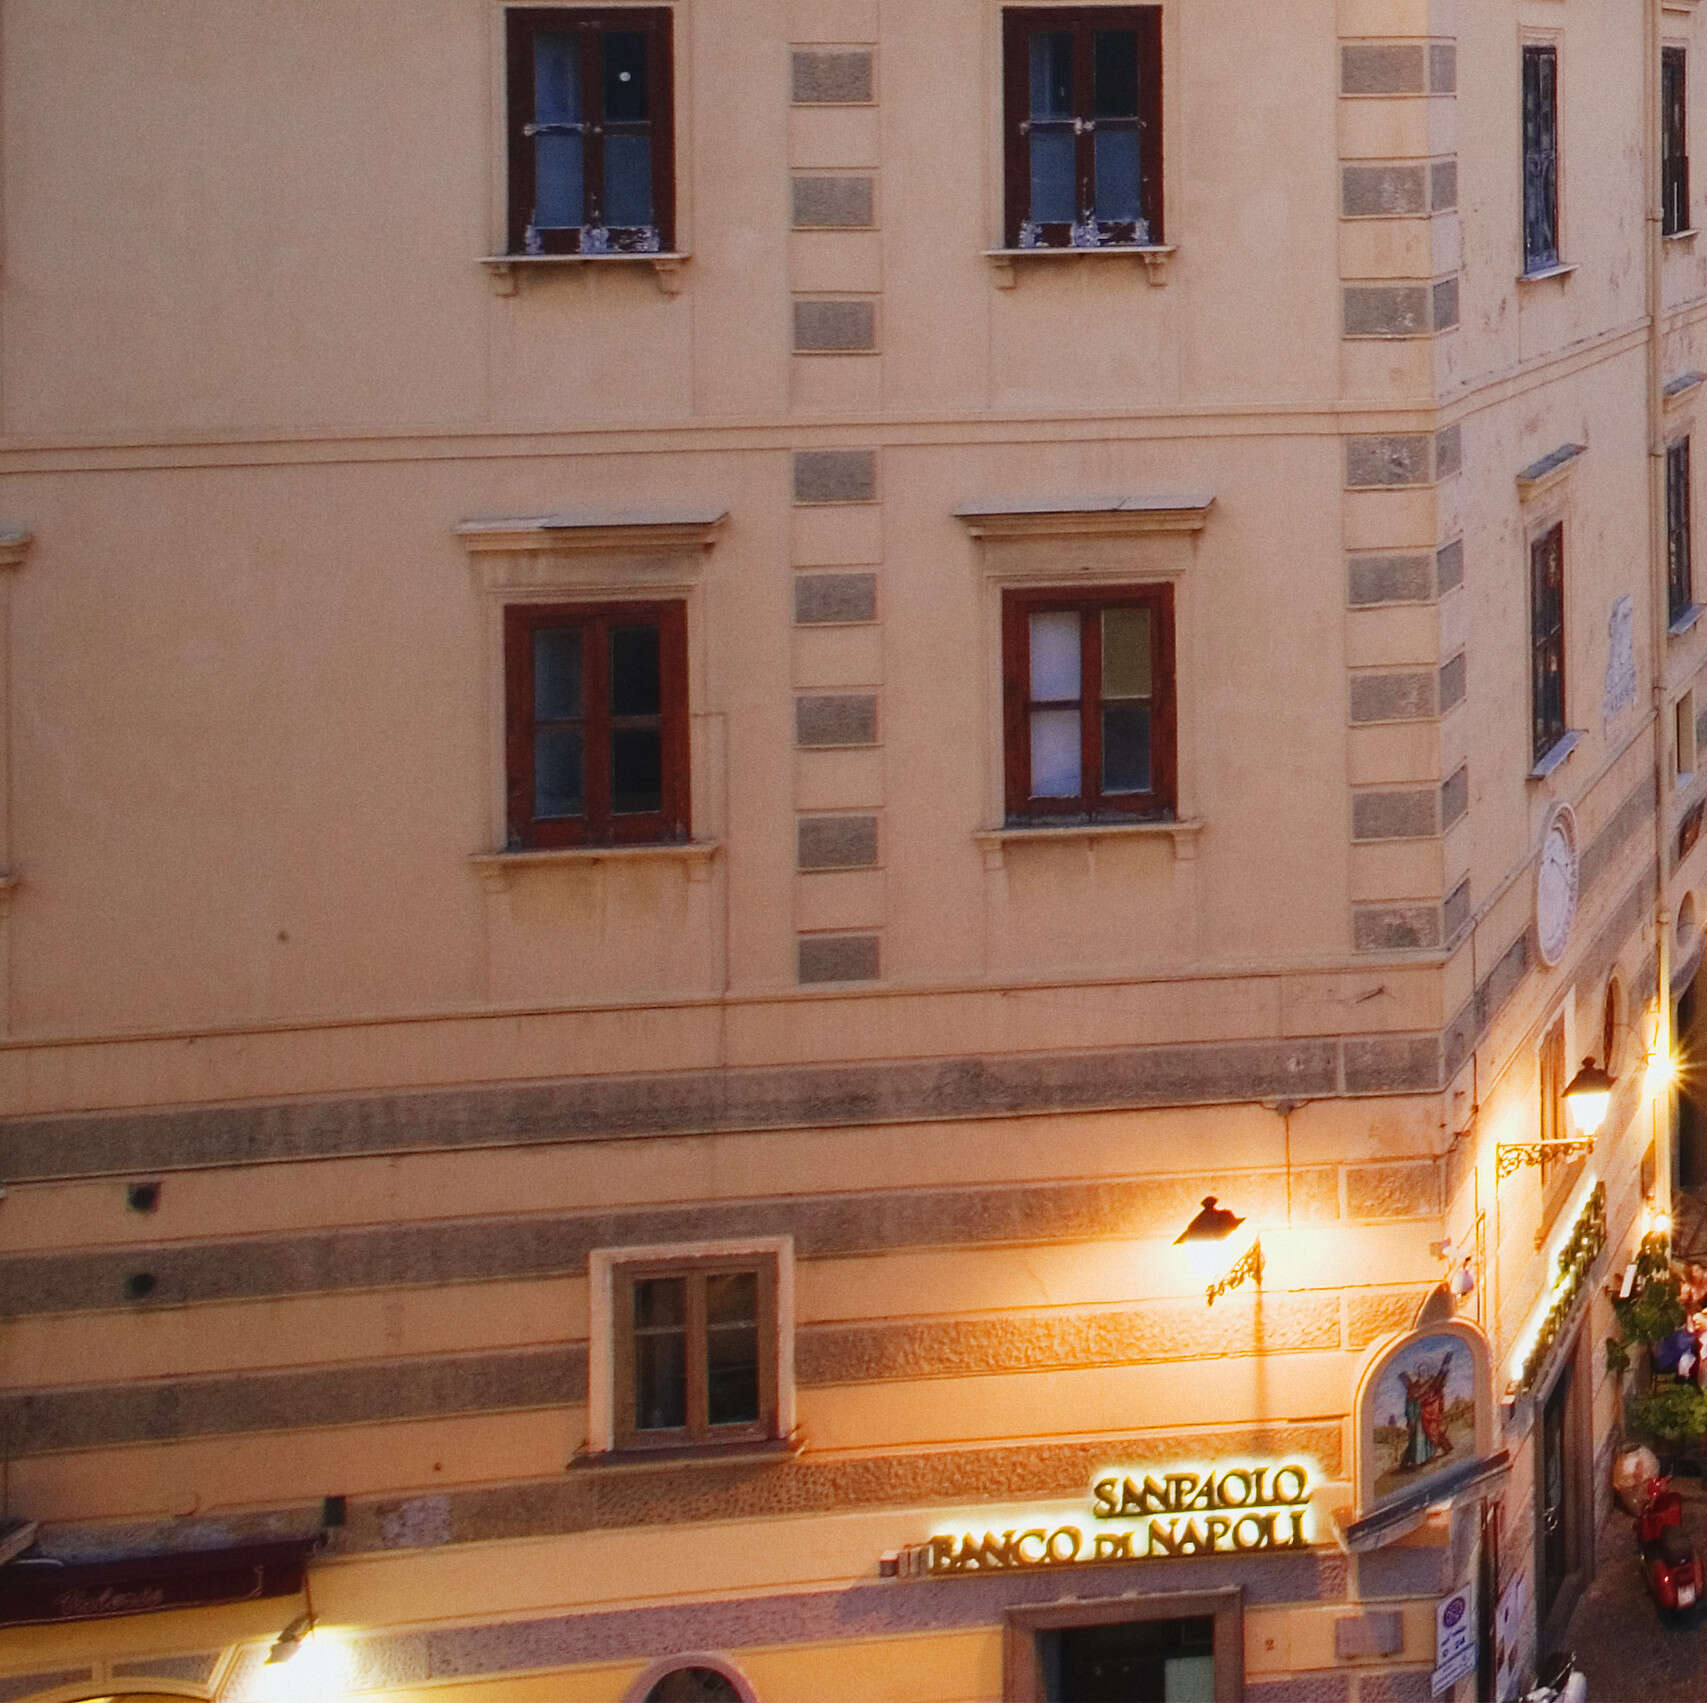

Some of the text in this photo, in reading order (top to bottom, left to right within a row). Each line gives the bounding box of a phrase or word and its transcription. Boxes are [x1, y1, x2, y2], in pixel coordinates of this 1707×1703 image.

[1092, 1464, 1312, 1518] SANPAOLO
[930, 1524, 1083, 1573] BANCO
[1147, 1510, 1310, 1557] NAPOLI
